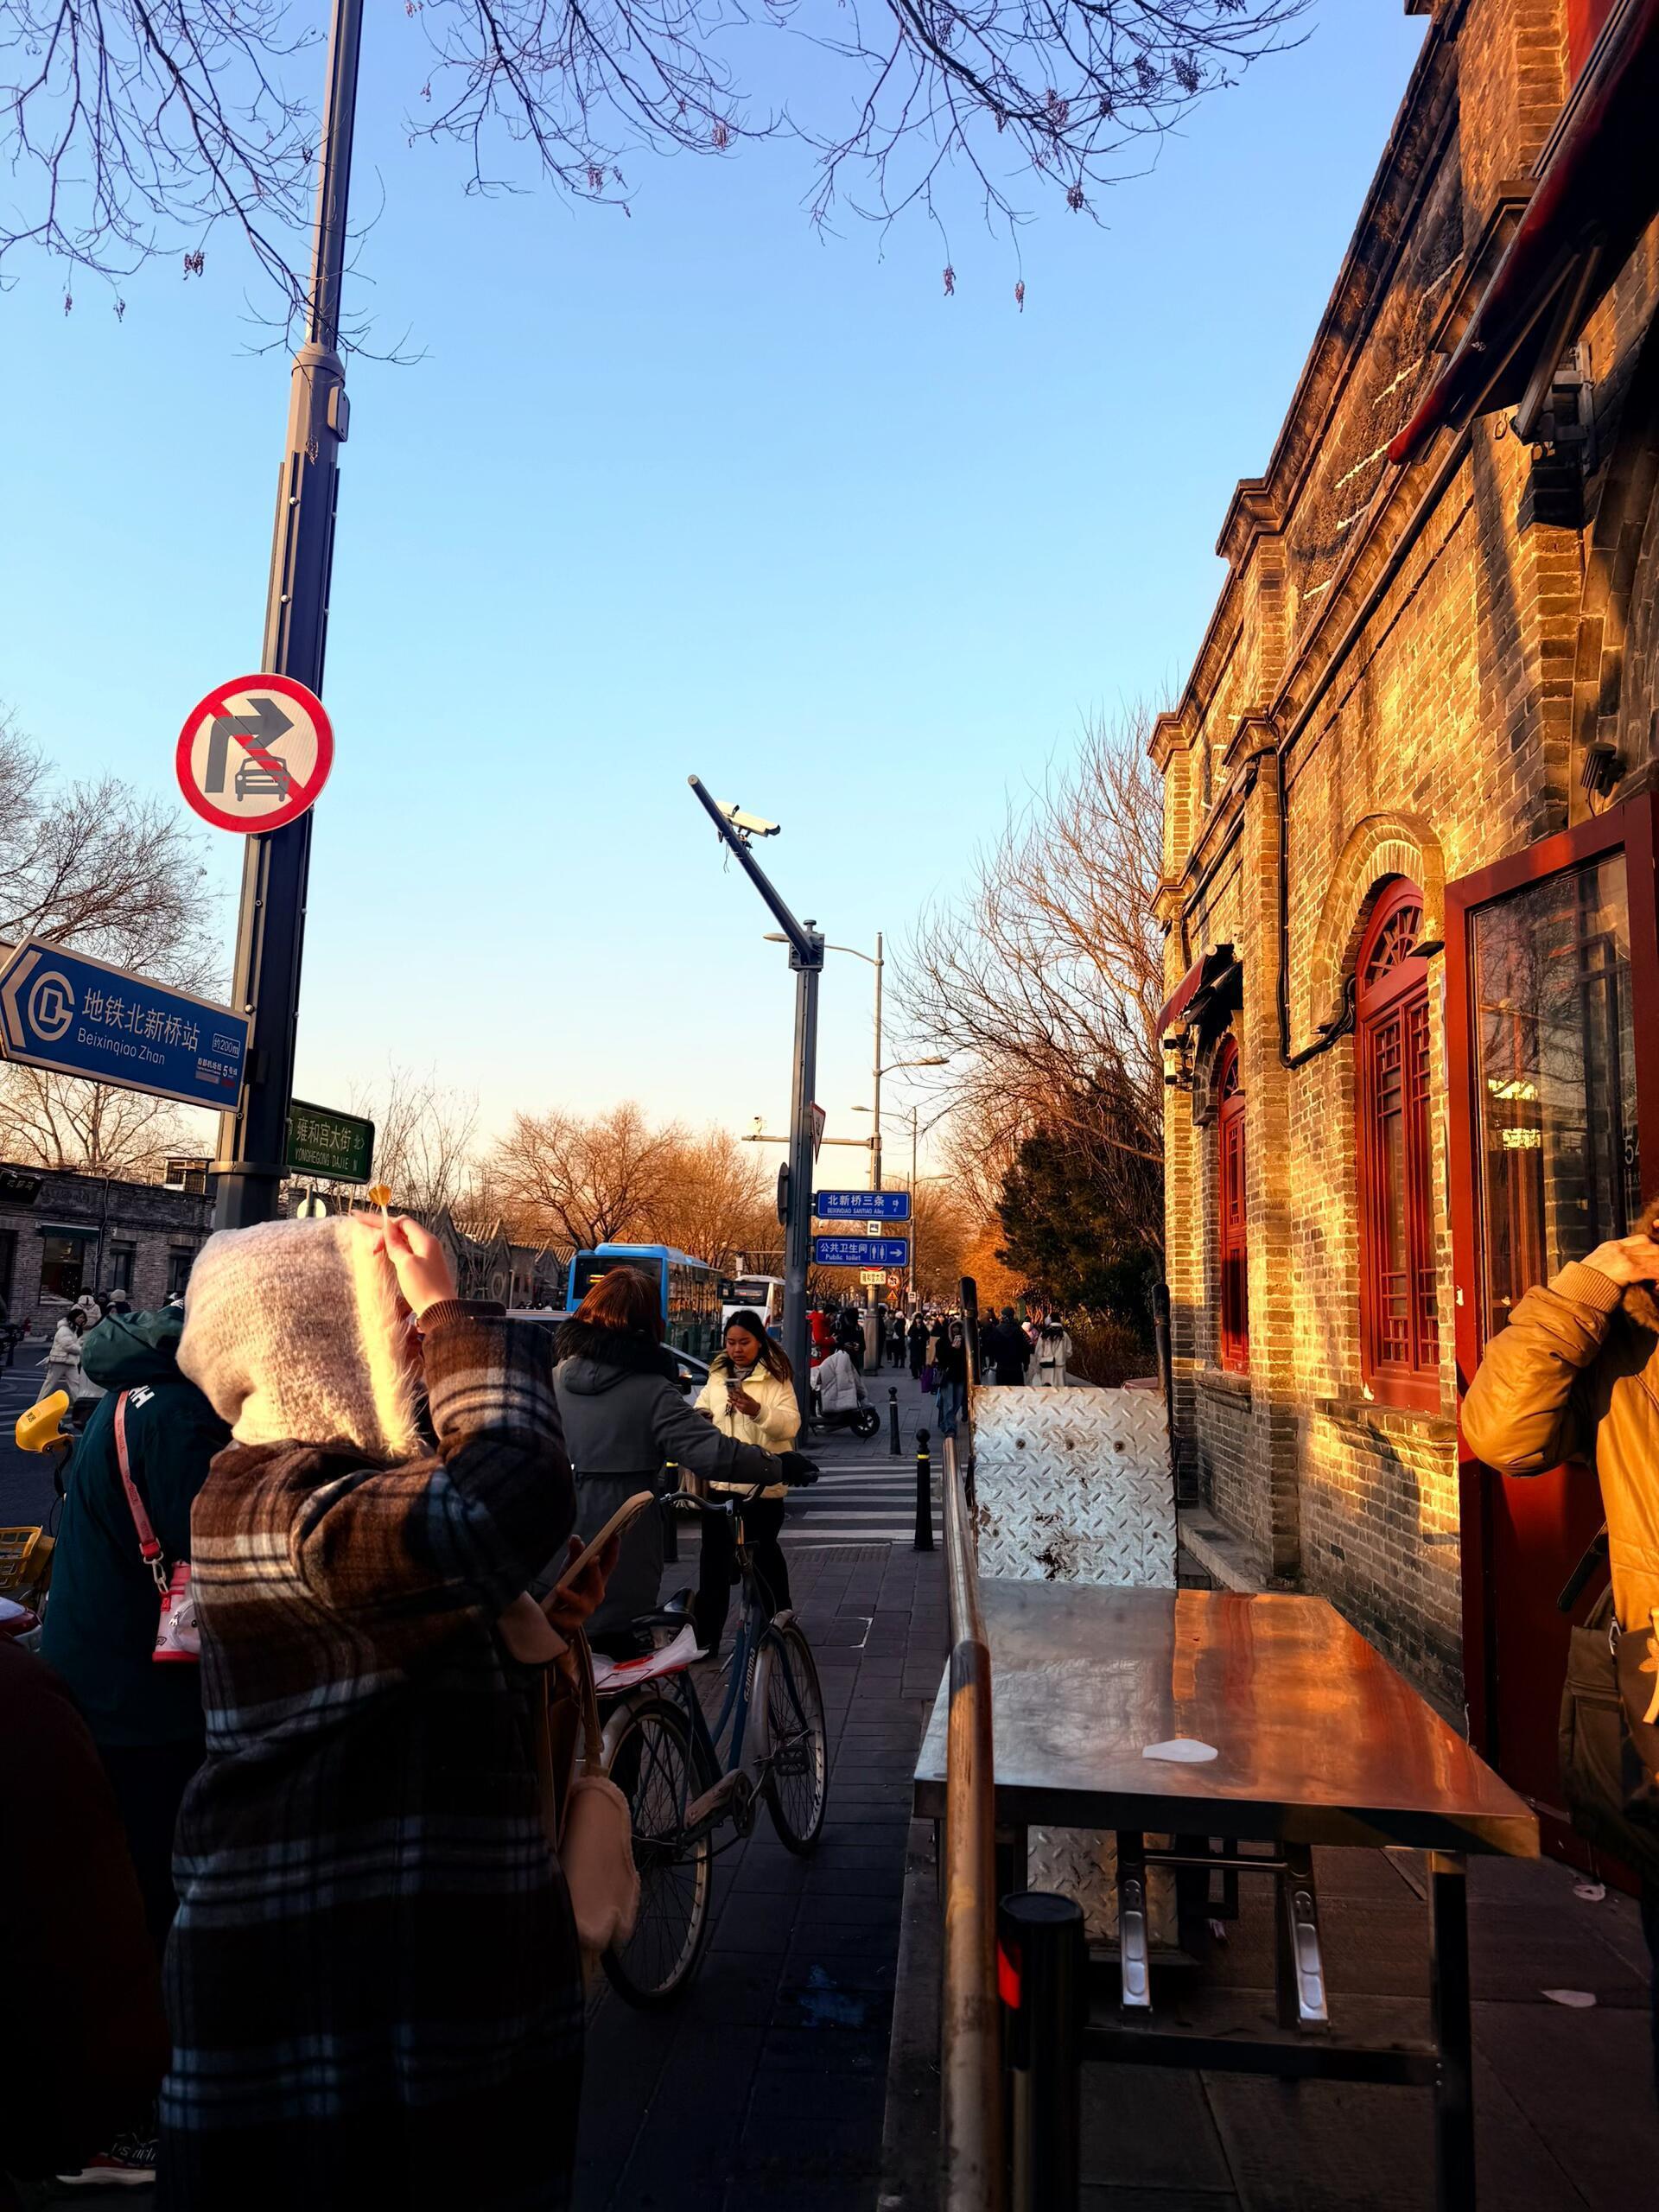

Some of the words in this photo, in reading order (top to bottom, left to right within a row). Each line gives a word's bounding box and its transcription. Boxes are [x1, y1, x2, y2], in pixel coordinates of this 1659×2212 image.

[82, 988, 200, 1052] 地铁北新桥站
[78, 1027, 137, 1056] Beixinqiao
[138, 1046, 165, 1065] Zhan
[213, 1037, 239, 1054] 约200m
[296, 1116, 352, 1152] 雍和宫大街
[828, 1194, 885, 1207] 北新桥三条
[820, 1243, 868, 1253] 公共卫生间
